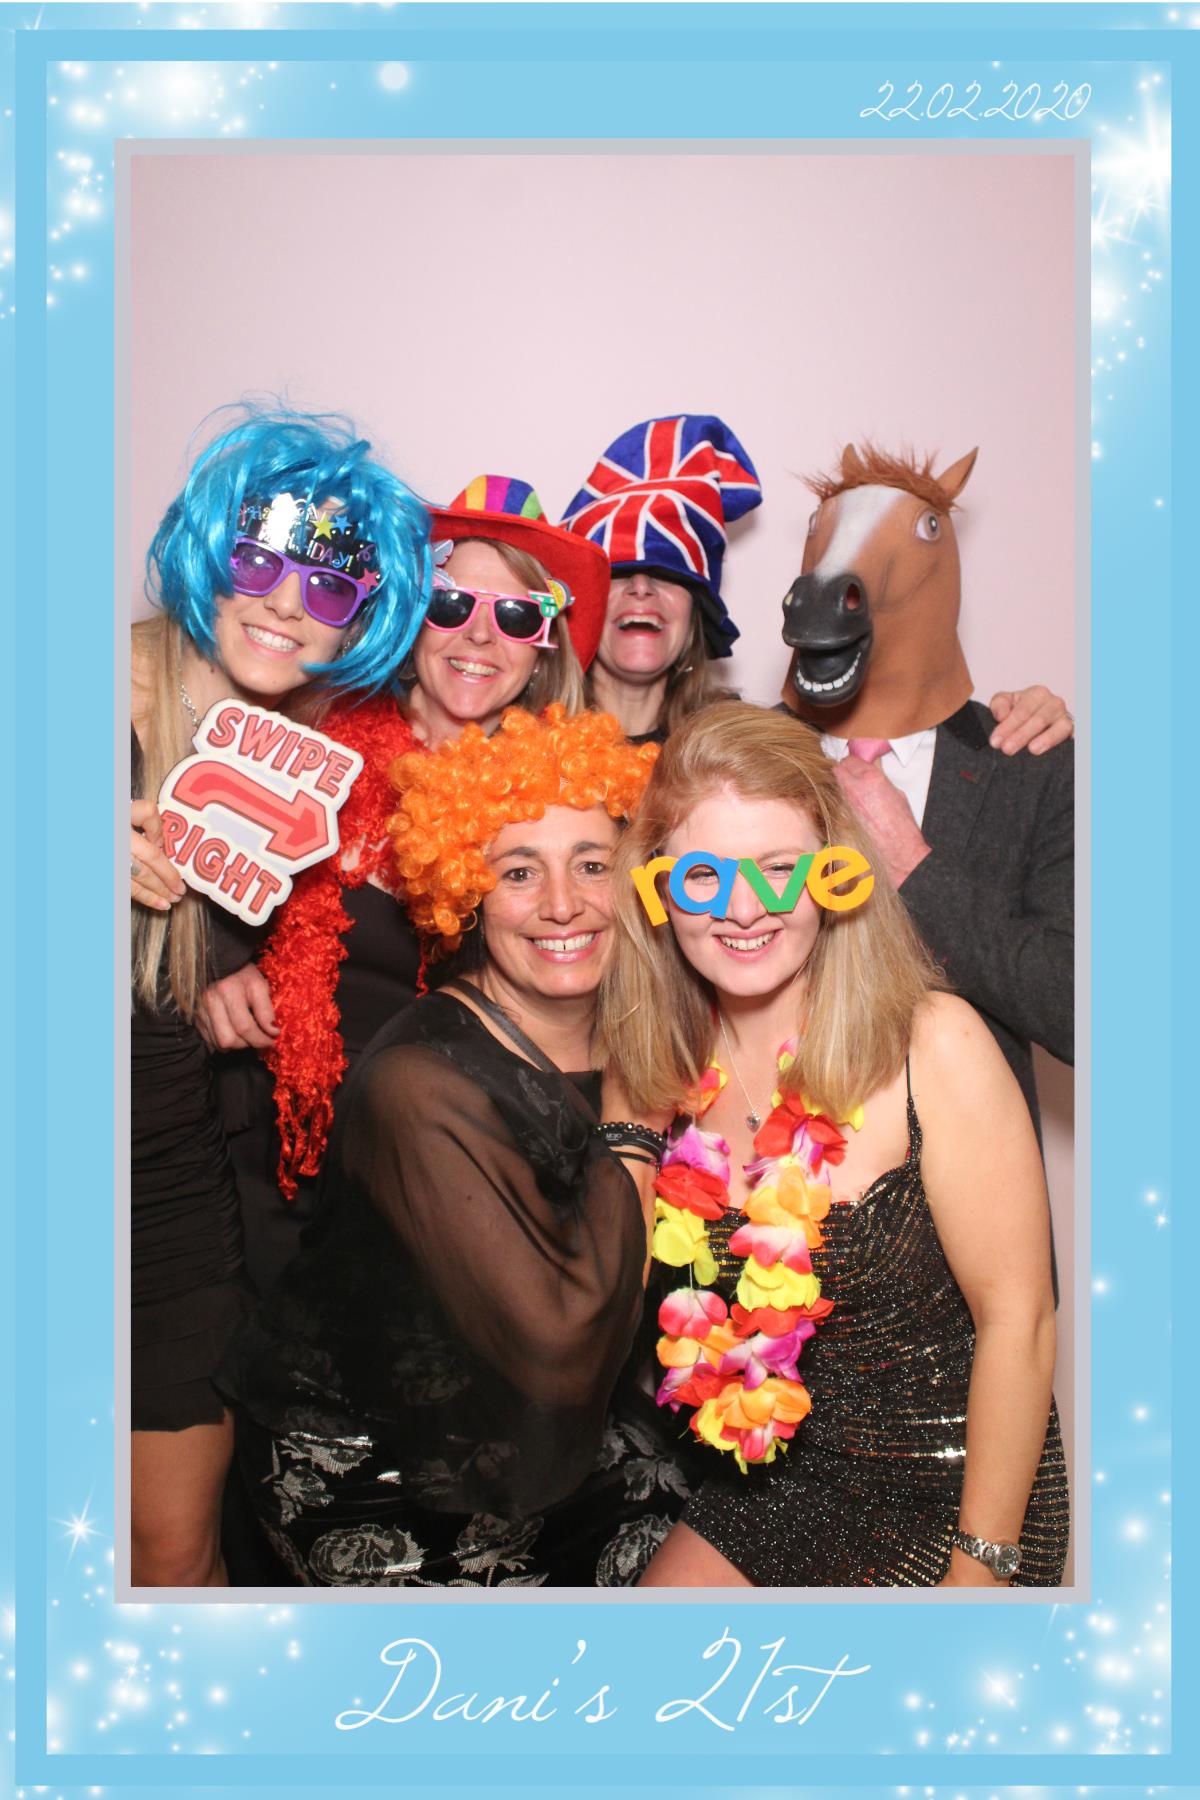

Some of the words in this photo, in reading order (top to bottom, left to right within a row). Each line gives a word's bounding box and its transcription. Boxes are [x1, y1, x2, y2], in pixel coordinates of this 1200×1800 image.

[206, 707, 354, 799] SWIPE
[160, 809, 283, 915] RIGHT
[630, 846, 875, 927] rave
